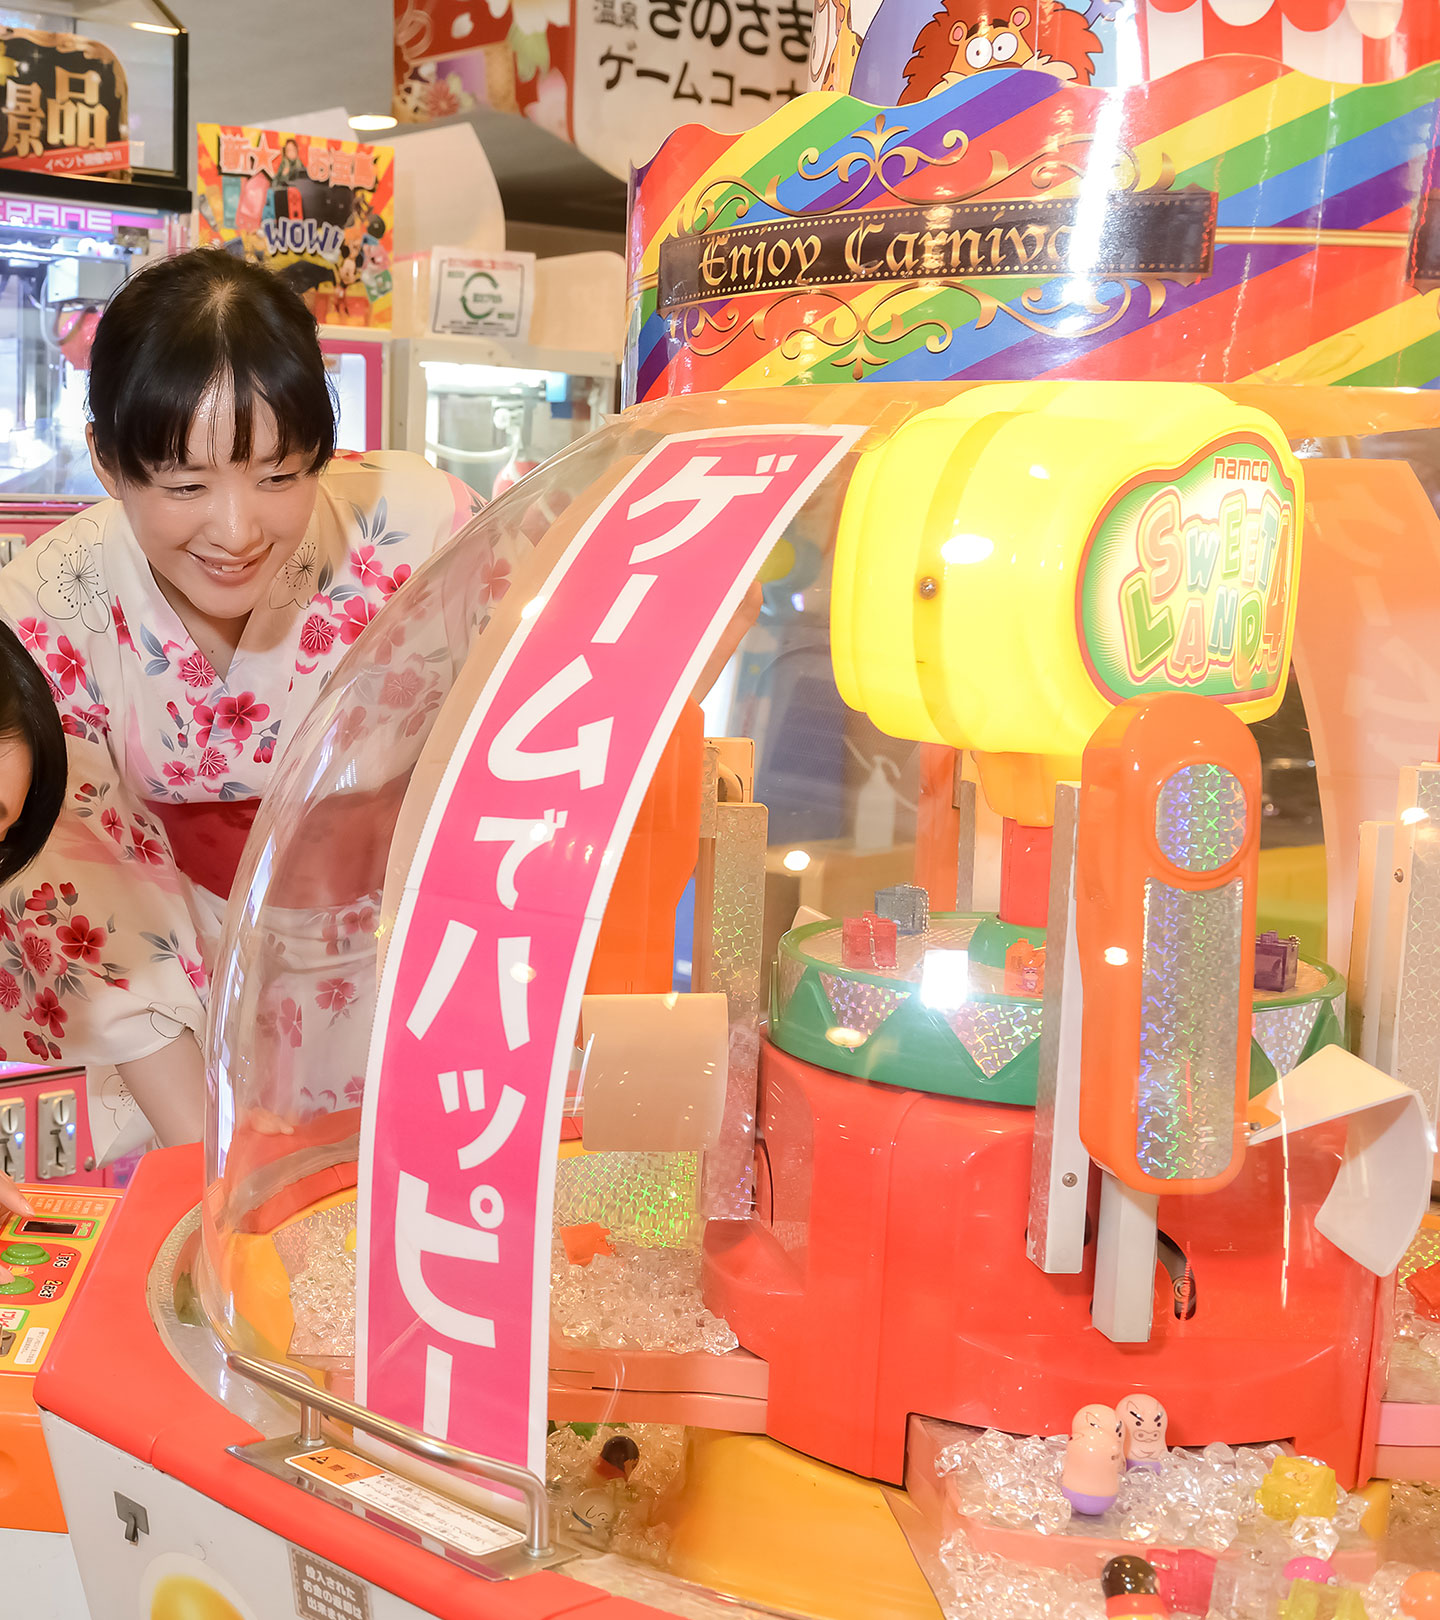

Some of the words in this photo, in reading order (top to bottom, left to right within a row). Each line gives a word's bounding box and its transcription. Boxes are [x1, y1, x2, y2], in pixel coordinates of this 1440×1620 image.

[699, 227, 822, 288] Enjoy
[1213, 458, 1270, 483] namco
[1142, 493, 1280, 602] SWEET
[1125, 584, 1263, 672] LAND
[392, 452, 796, 1440] ゲームでハッピー
